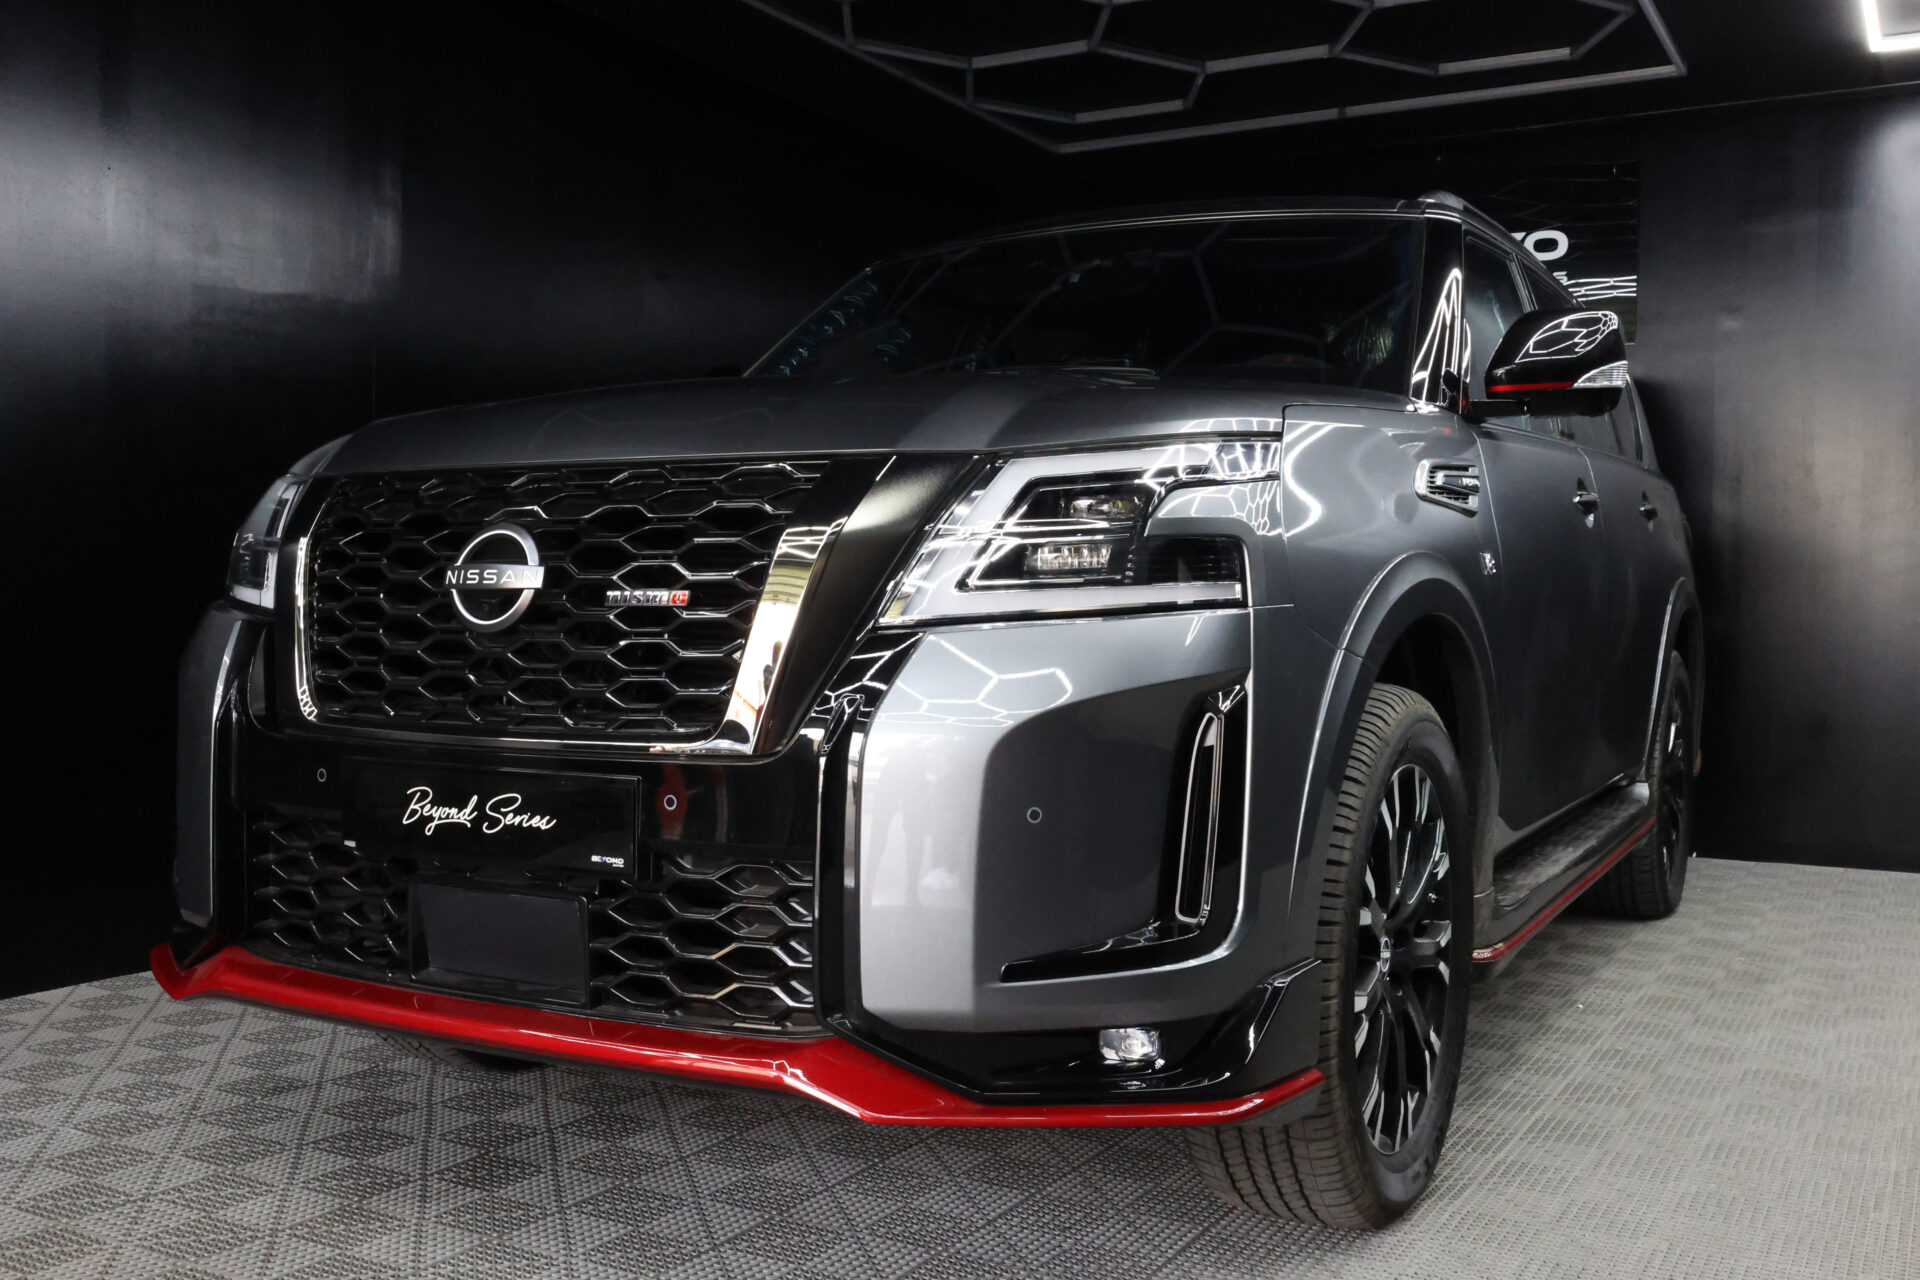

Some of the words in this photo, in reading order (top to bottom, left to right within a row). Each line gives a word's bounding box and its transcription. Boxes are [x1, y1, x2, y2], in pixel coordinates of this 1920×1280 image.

[445, 569, 540, 585] NISSAN
[402, 786, 478, 836] Beyond
[482, 793, 557, 834] Series
